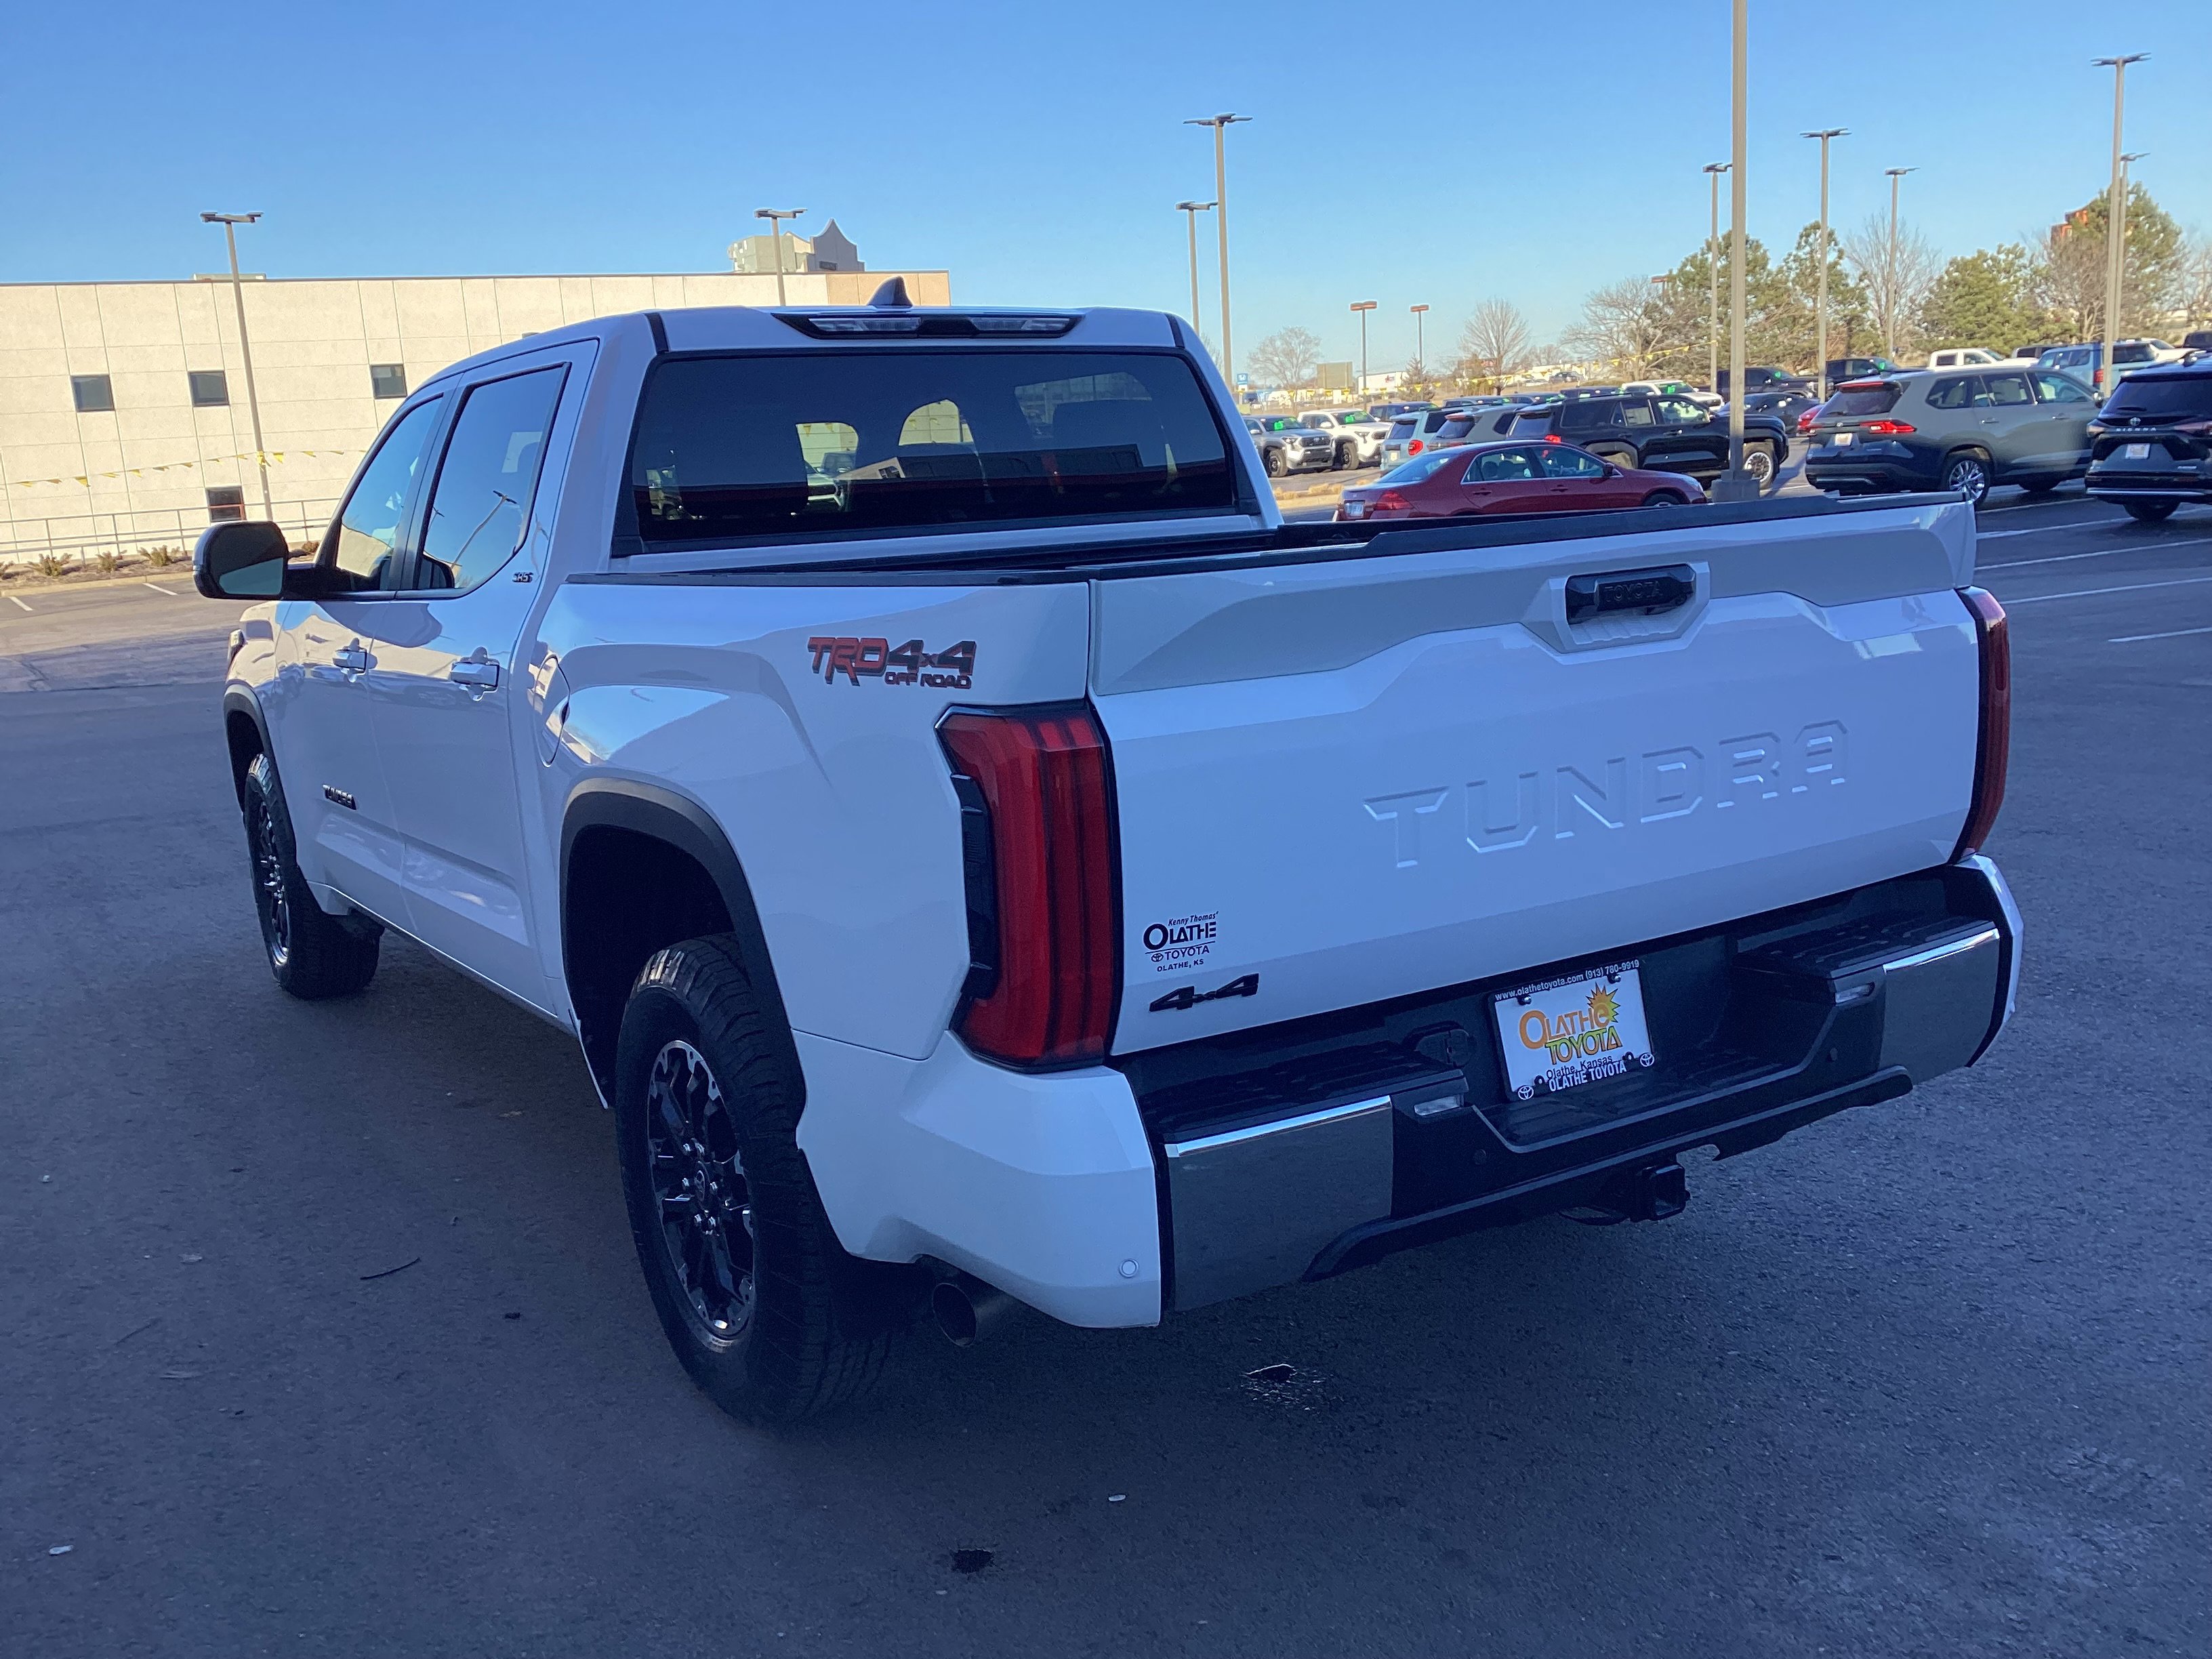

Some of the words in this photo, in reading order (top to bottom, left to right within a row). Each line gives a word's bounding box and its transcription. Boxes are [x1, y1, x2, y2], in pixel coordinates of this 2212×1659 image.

[1604, 581, 1663, 602] TOYOTA
[808, 637, 889, 687] TRD
[884, 672, 918, 686] OFF
[920, 673, 972, 689] ROAD
[1364, 720, 1847, 868] TUNDRA
[1168, 915, 1189, 926] Kenny
[1143, 921, 1217, 950] OLATHE
[1157, 961, 1192, 972] OLATHE,
[1193, 958, 1204, 966] KS
[1164, 945, 1210, 960] TOYOTA
[1495, 974, 1584, 1002] www.olathetoyota.com
[1586, 967, 1604, 981] (913)
[1605, 959, 1640, 975] 780-9919
[1544, 1026, 1623, 1065] TOYOTA
[1549, 1070, 1589, 1092] OLATHE
[1589, 1059, 1627, 1081] TOYOTA
[1580, 1056, 1612, 1071] Kansas
